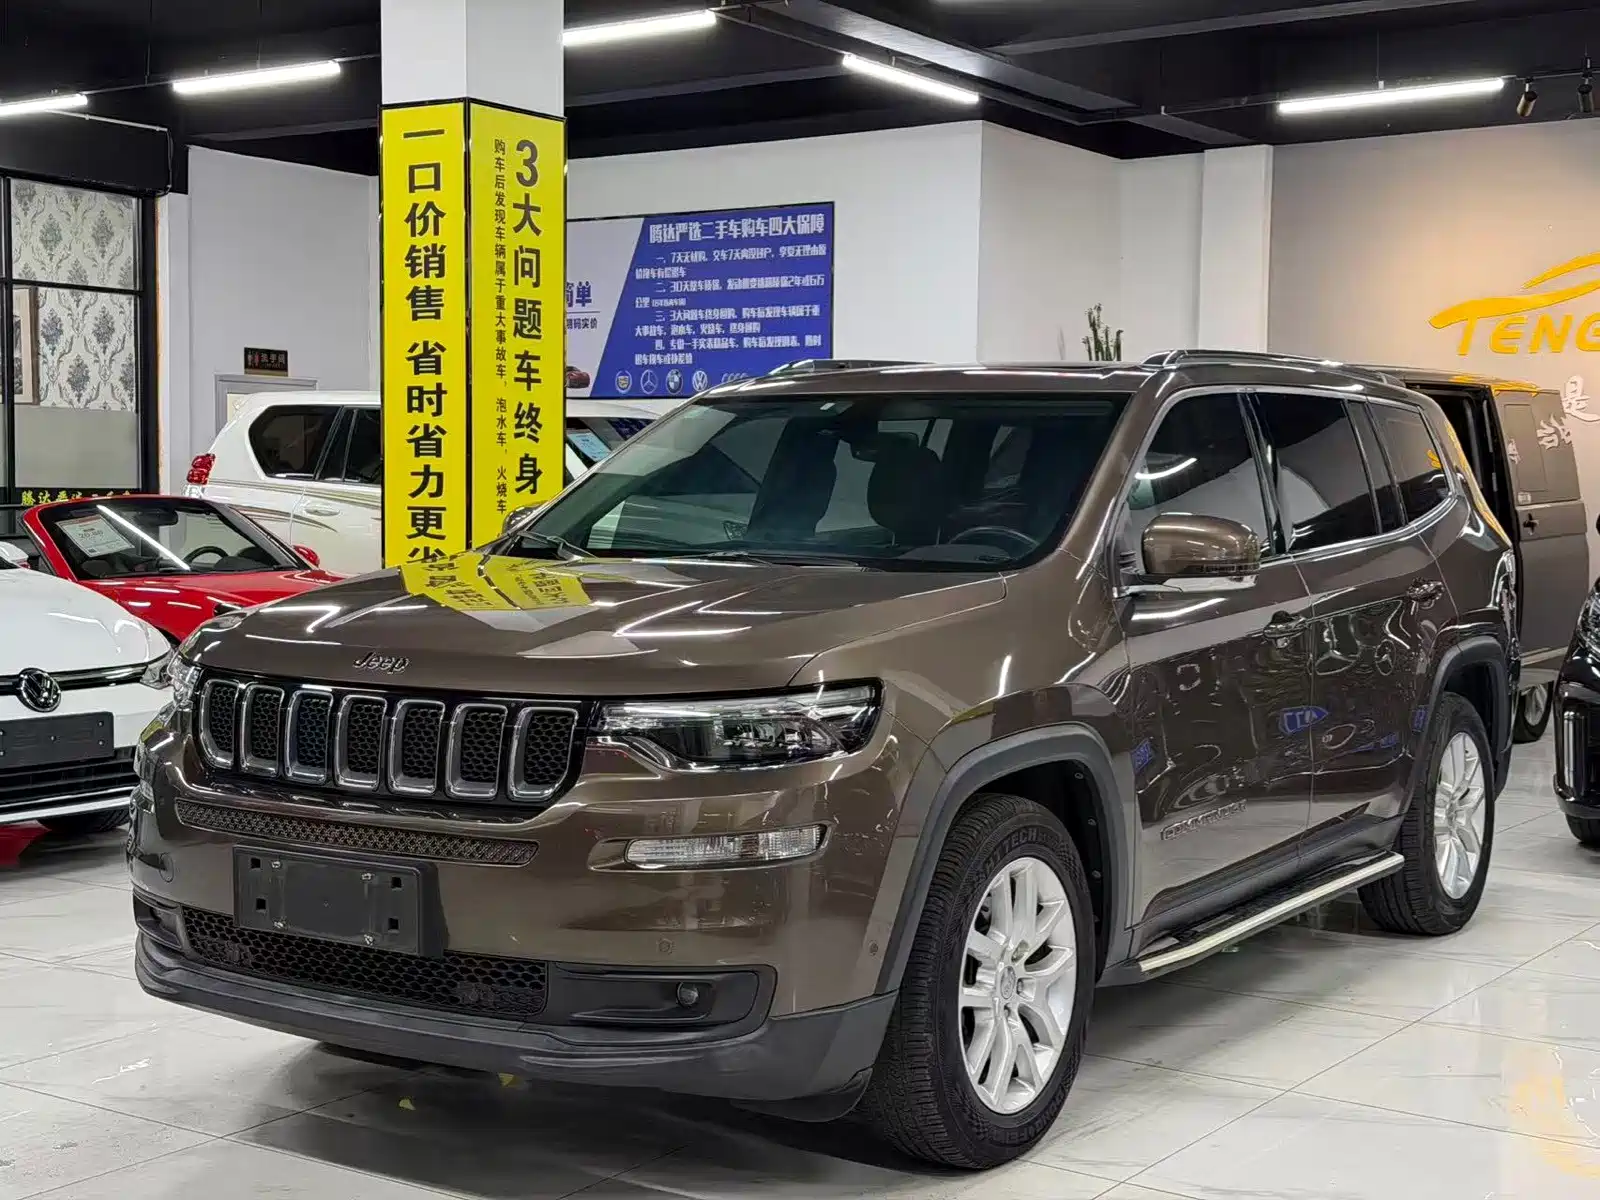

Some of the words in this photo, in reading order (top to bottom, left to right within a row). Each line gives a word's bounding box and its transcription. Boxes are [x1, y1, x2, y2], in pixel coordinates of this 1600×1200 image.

[403, 128, 447, 322] 一口价销售
[511, 139, 544, 495] 3大问题车终身
[649, 213, 825, 244] 腾达严选二手车购车四大保障
[493, 138, 508, 537] 购车后发现车辆属于重大事故车，泡水车，火烧车
[352, 652, 410, 675] Jeep
